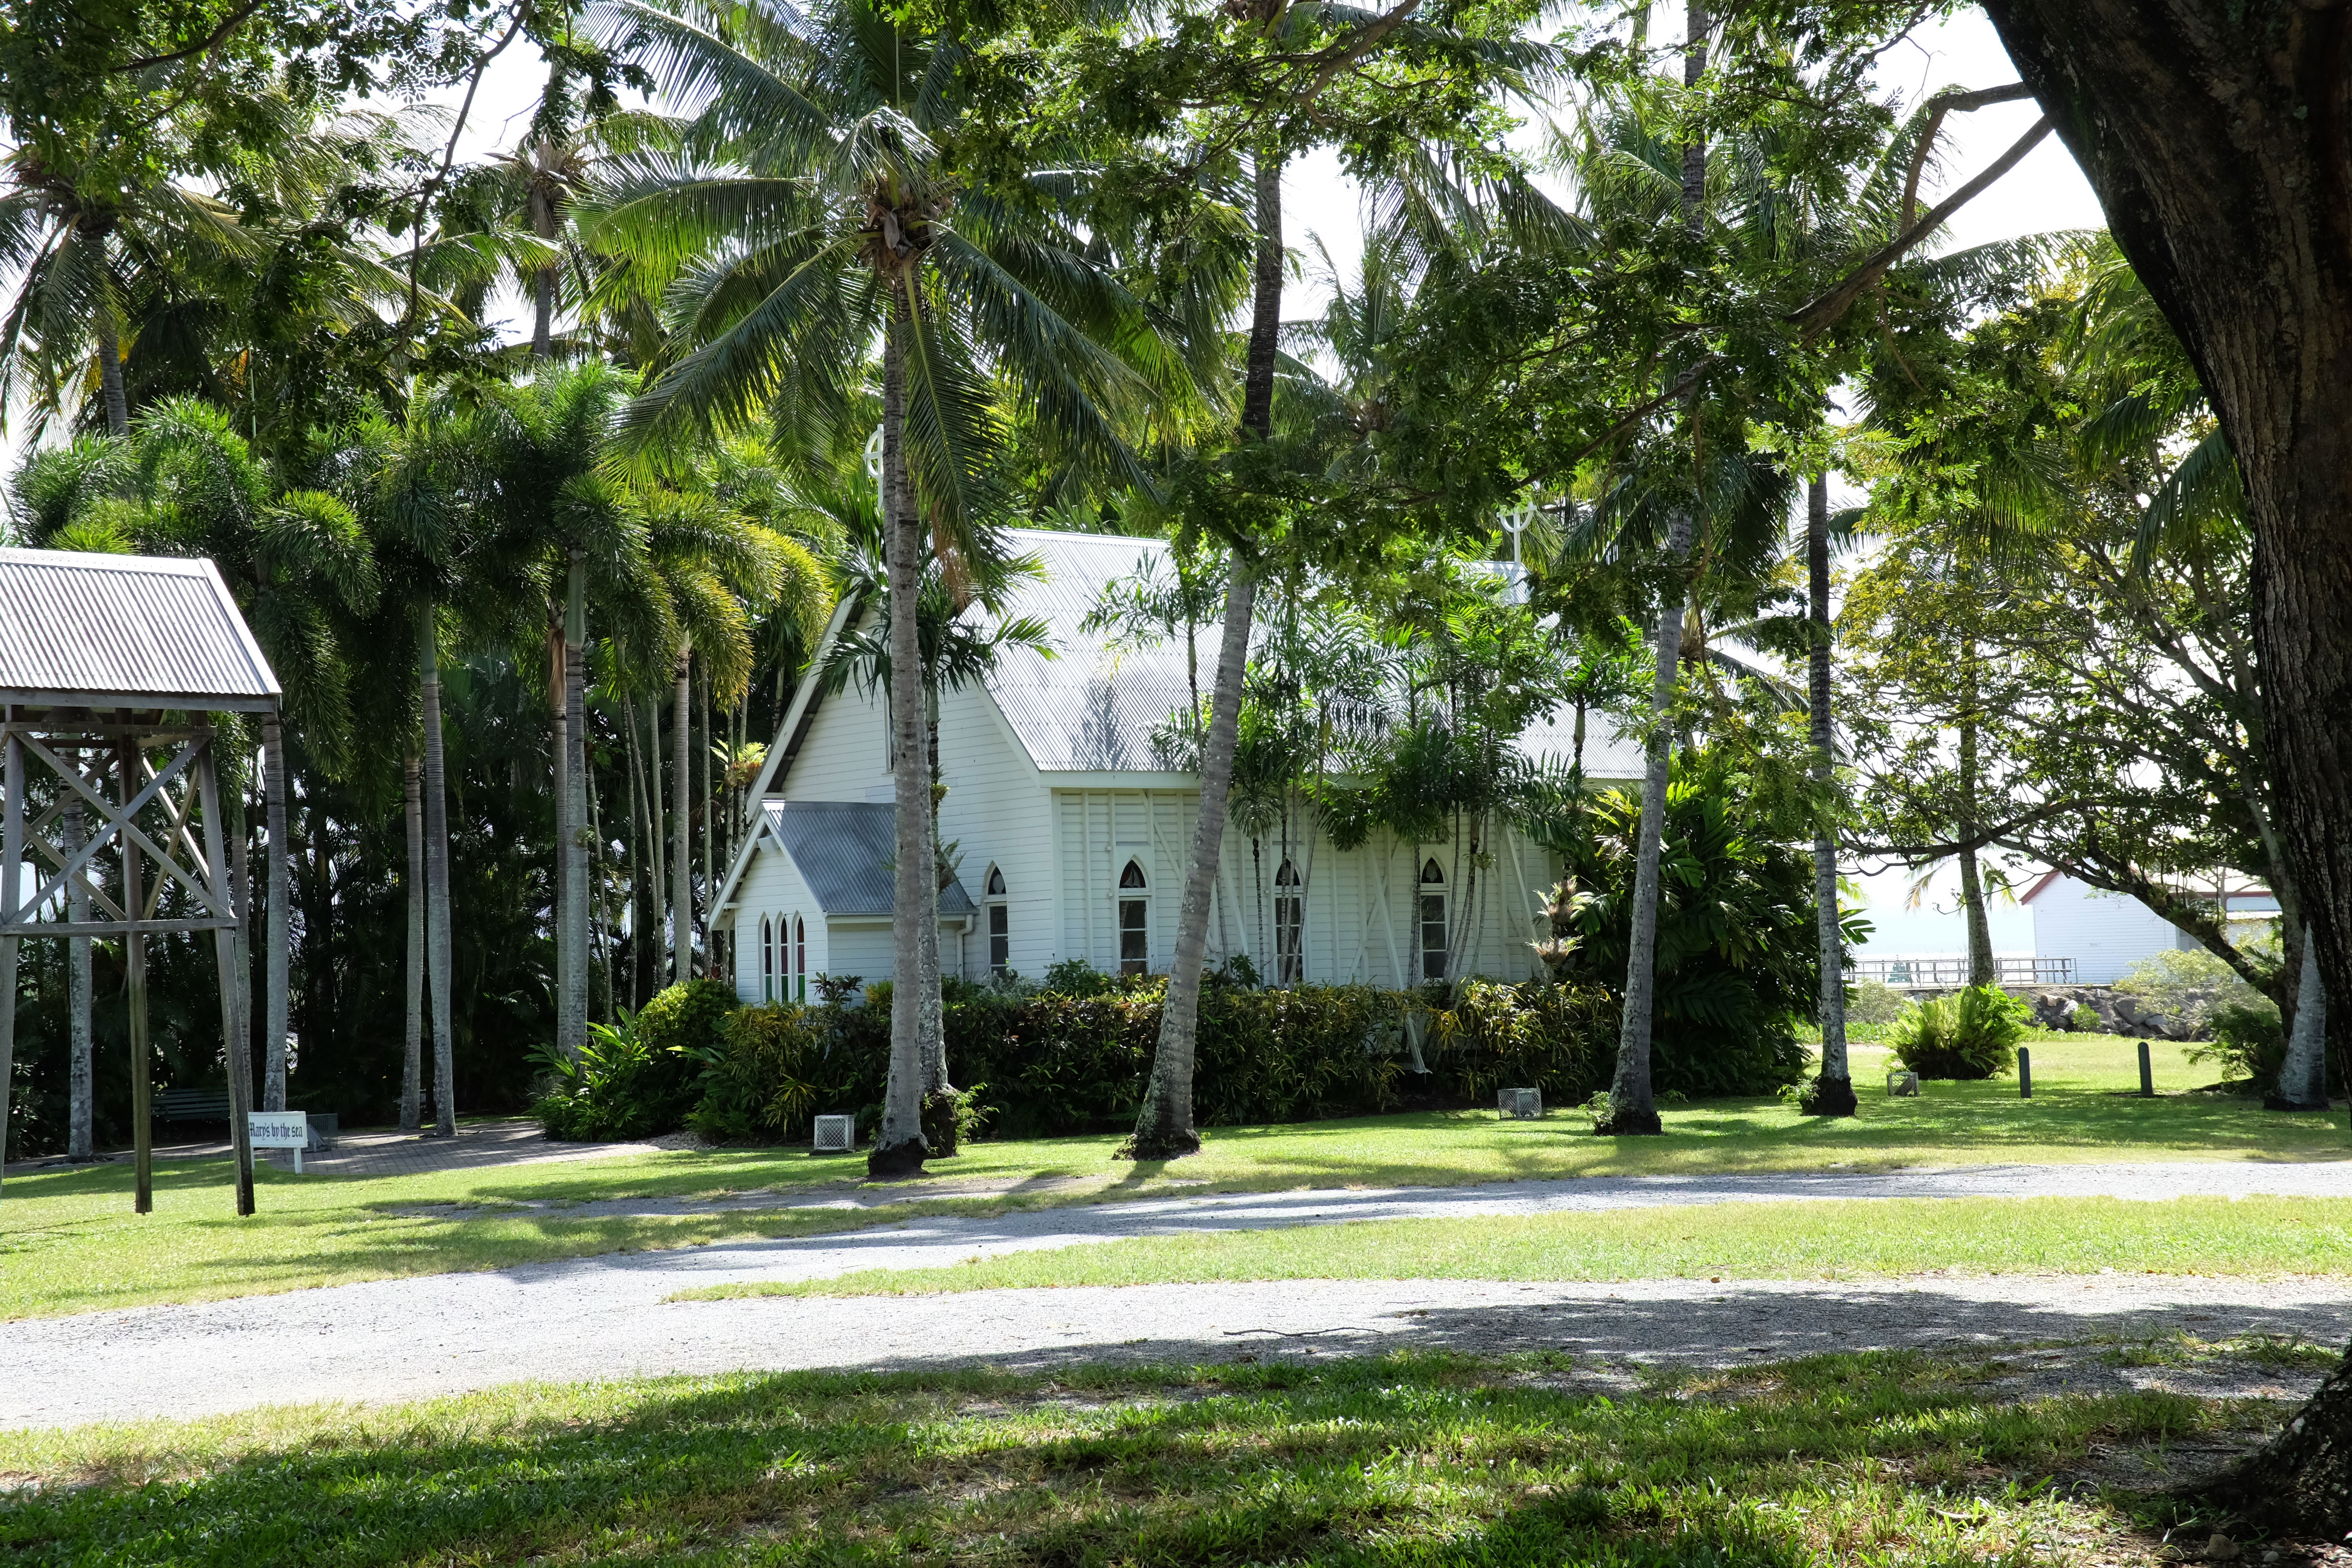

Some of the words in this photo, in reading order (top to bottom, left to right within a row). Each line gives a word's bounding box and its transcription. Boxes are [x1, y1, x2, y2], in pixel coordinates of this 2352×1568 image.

[271, 1122, 279, 1141] by
[280, 1122, 290, 1140] the
[292, 1125, 303, 1137] sea
